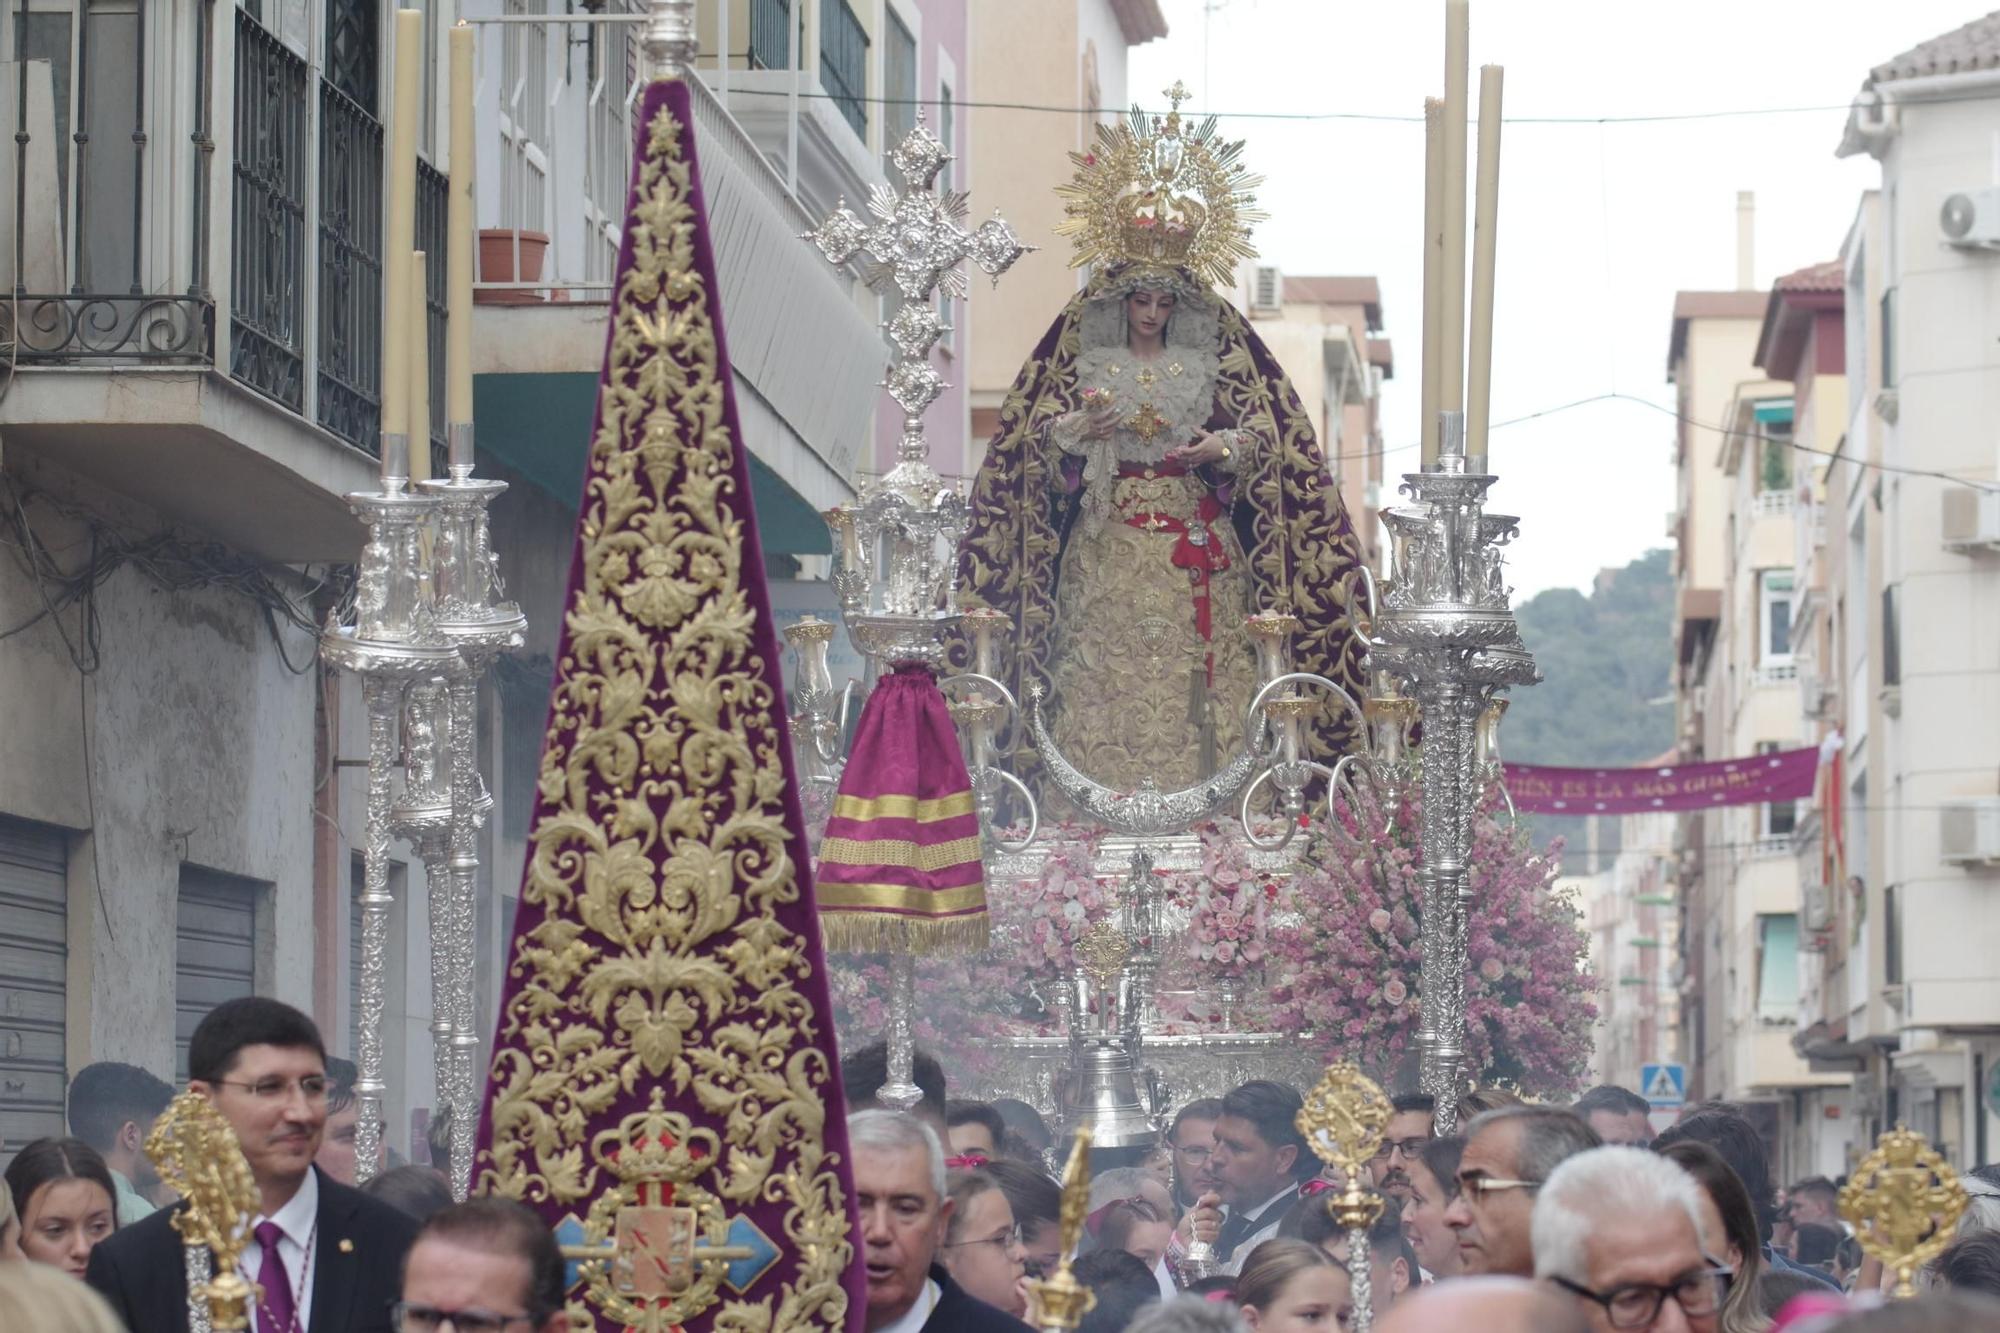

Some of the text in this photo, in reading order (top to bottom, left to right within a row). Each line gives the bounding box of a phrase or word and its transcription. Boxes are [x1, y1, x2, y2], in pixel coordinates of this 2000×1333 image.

[1502, 775, 1553, 798] UIÉN
[1561, 781, 1588, 798] ES
[1594, 781, 1623, 799] LA
